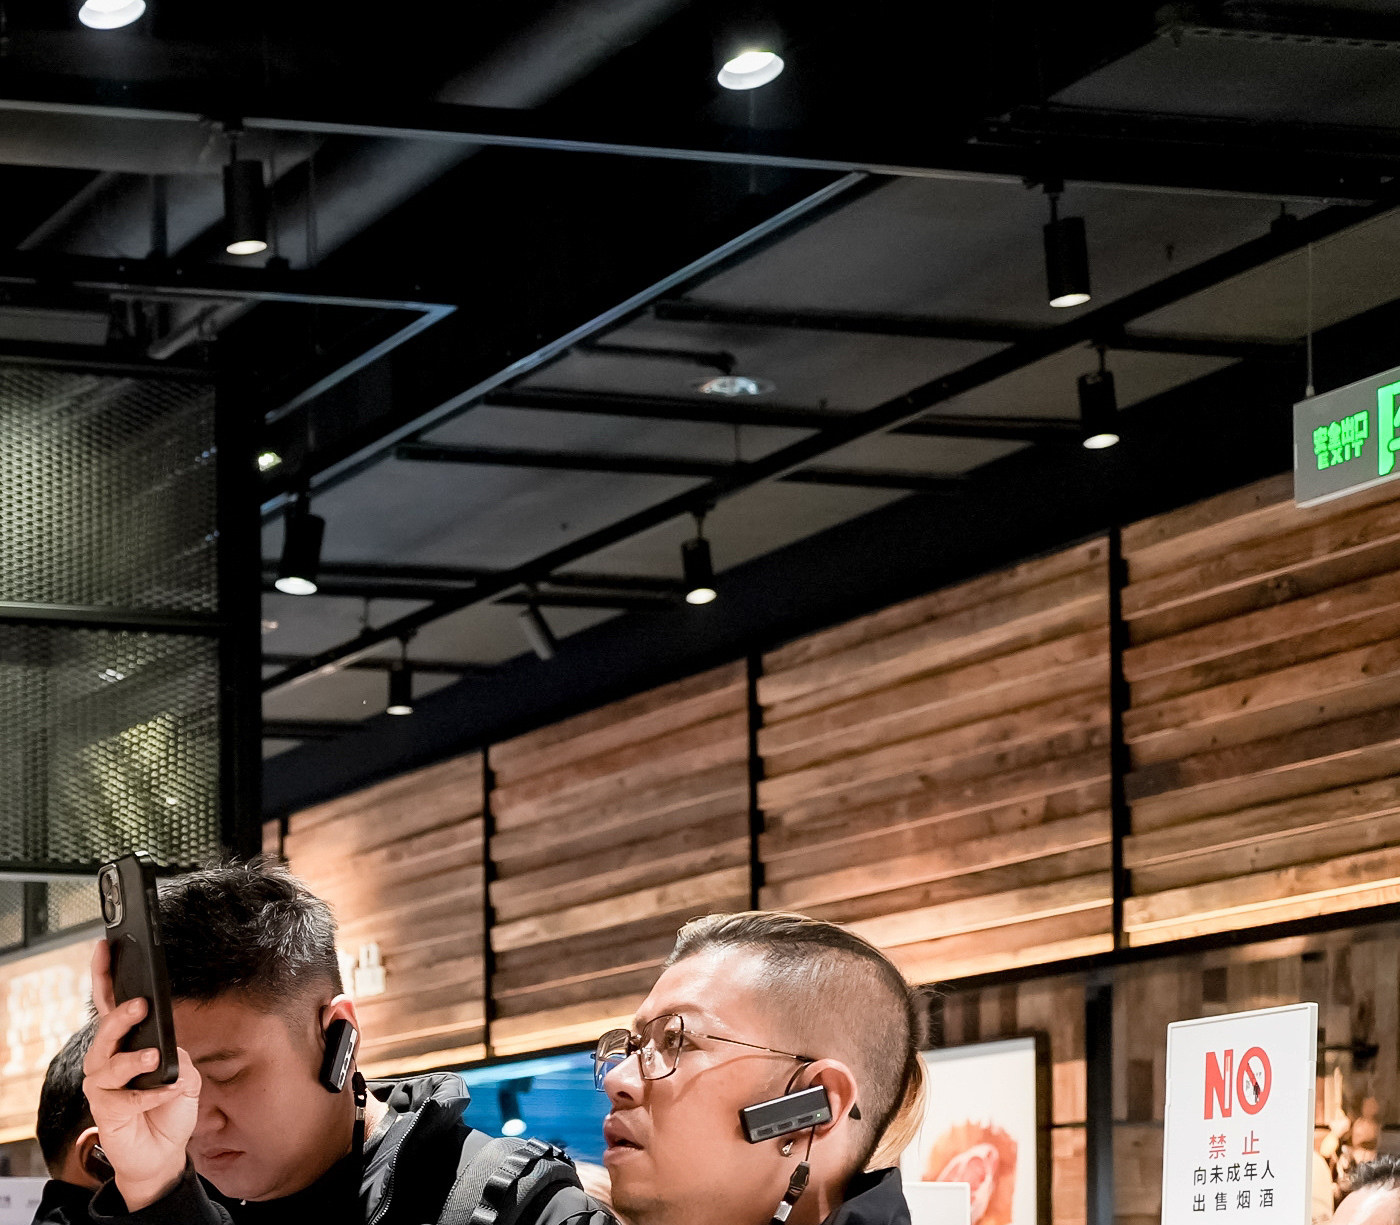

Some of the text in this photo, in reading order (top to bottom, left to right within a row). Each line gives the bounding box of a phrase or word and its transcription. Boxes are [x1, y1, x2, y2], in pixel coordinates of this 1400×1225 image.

[1317, 439, 1364, 470] EXIT
[1204, 1046, 1272, 1120] NO
[1209, 1131, 1260, 1159] 禁止
[1193, 1160, 1275, 1186] 向未成年人
[1193, 1189, 1274, 1212] 出售烟酒
